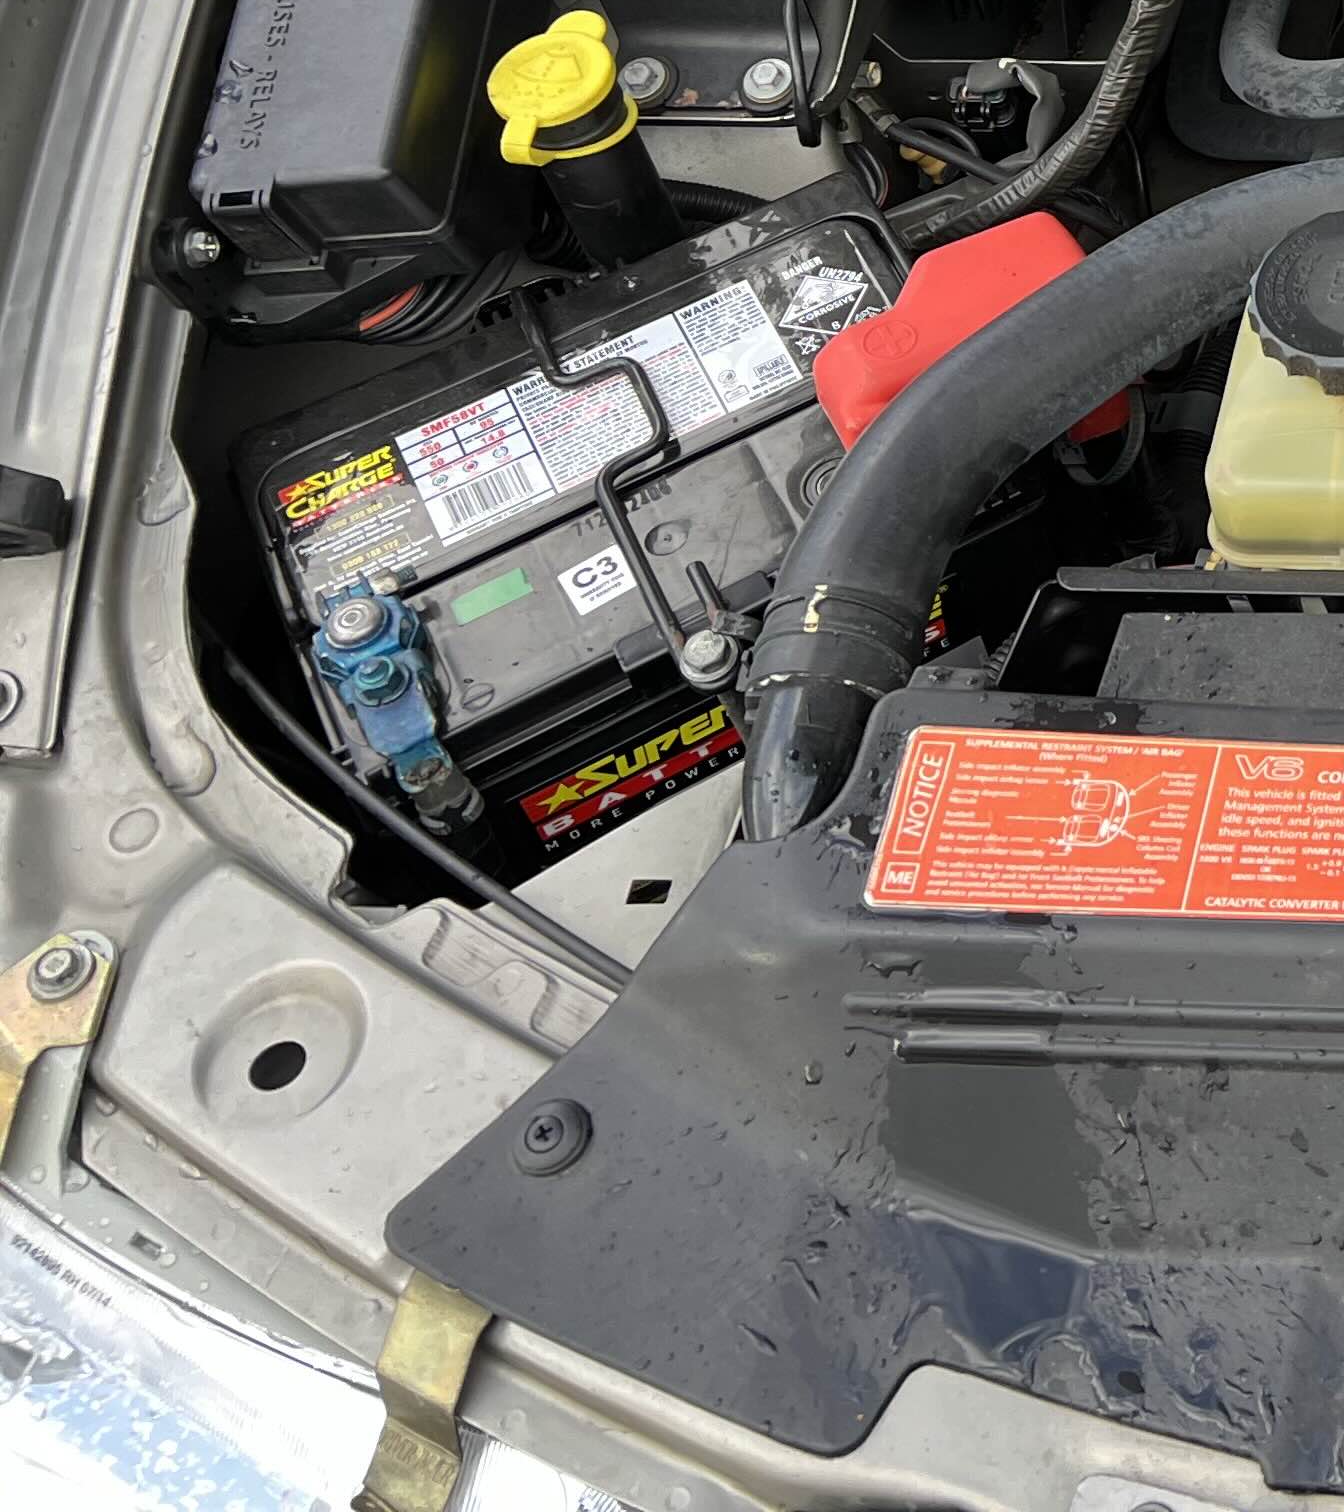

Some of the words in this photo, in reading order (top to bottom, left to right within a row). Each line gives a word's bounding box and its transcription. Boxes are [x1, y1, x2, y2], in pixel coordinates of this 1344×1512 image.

[239, 69, 279, 150] RELAYS
[818, 266, 864, 283] UN2794
[798, 293, 856, 324] CORROSIVE
[573, 336, 635, 370] STATEMENT
[420, 402, 486, 437] SMF58VT
[480, 429, 506, 445] 14.8
[419, 442, 441, 457] 550
[304, 445, 393, 489] SUPER
[286, 462, 395, 519] CHARGE
[572, 556, 618, 588] C3
[966, 738, 1039, 751] SUPPLEMENTAL
[1041, 743, 1092, 754] RESTRAINT
[1095, 745, 1132, 756] SYSTEM
[1234, 753, 1305, 782] V6
[545, 808, 623, 852] MORE
[644, 747, 740, 801] POWER
[902, 753, 943, 838] NOTICE
[1228, 787, 1250, 798] This
[1254, 789, 1294, 800] vehicle
[1297, 791, 1306, 800] is
[1309, 790, 1341, 801] fitted
[1224, 800, 1302, 814] Management
[1221, 813, 1243, 824] idle
[1247, 815, 1283, 827] speed,
[1287, 816, 1311, 827] and
[1218, 826, 1250, 838] these
[1253, 828, 1308, 840] functions
[1311, 831, 1330, 841] are
[1272, 845, 1297, 855] PLUG
[887, 870, 914, 885] ME
[1204, 896, 1266, 909] CATALYTIC
[1269, 898, 1339, 911] CONVERTER
